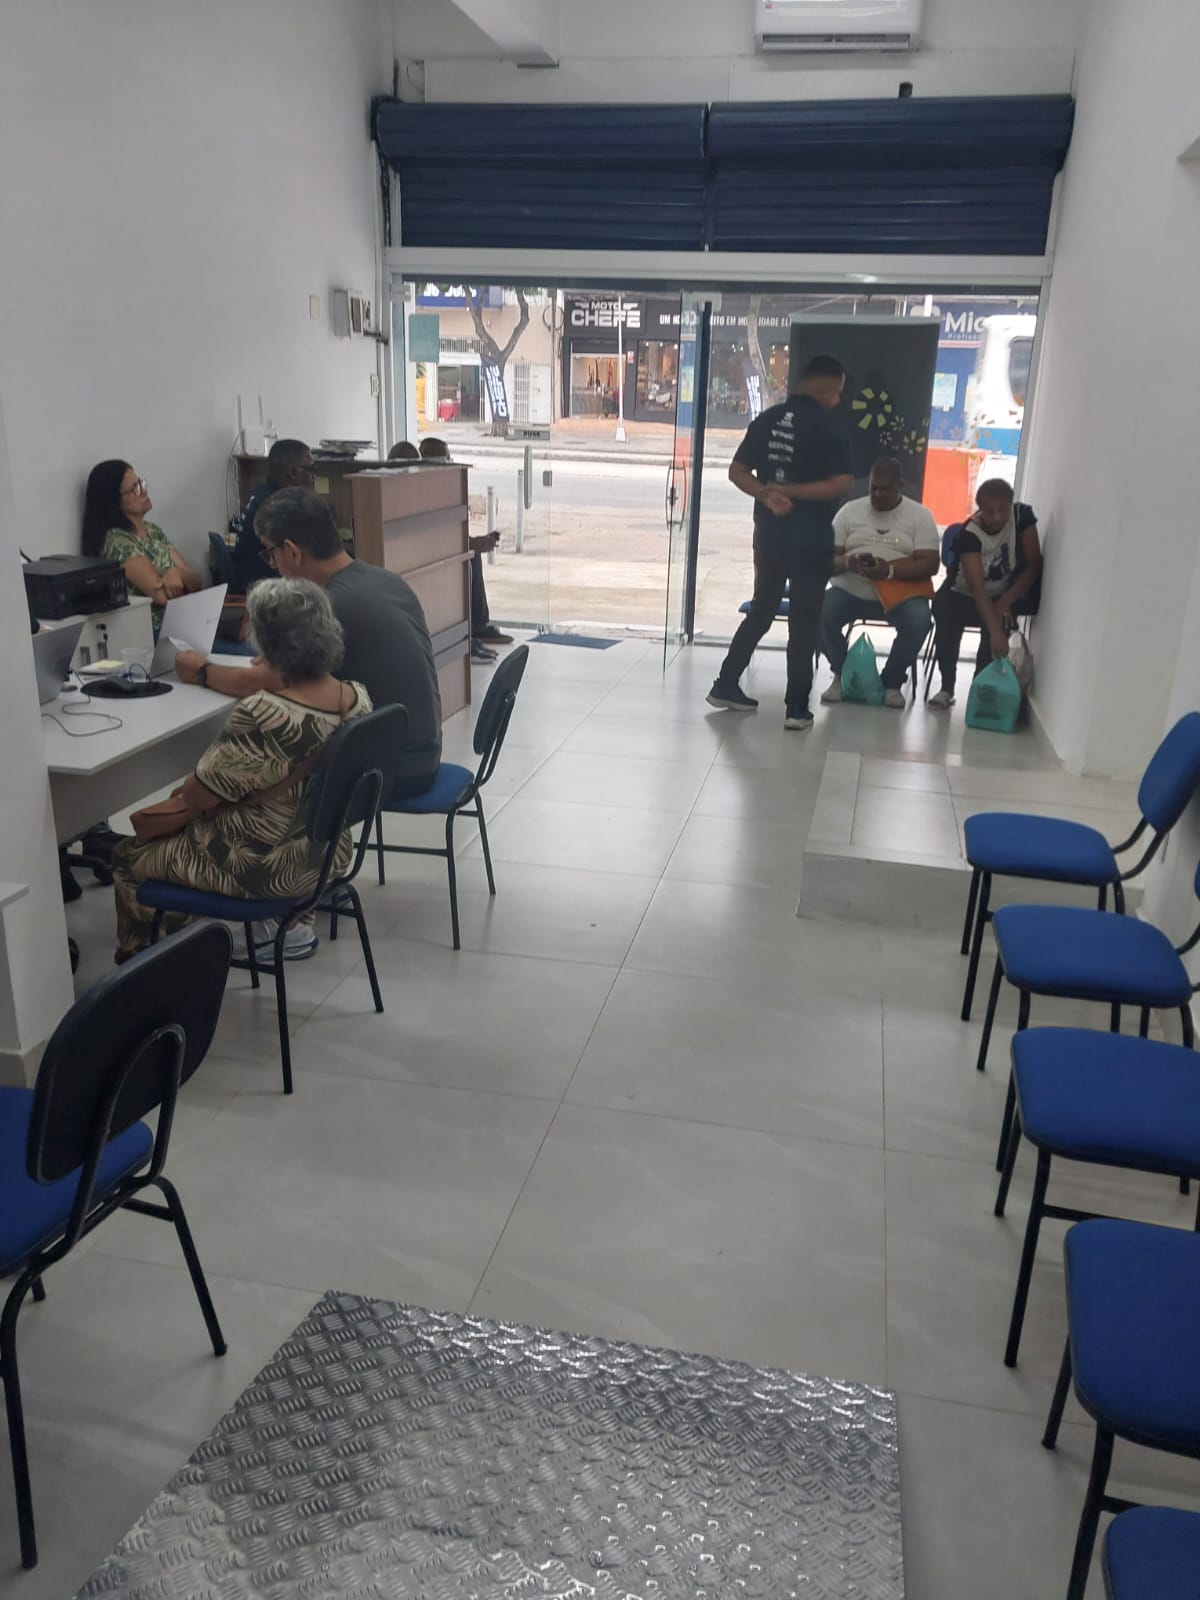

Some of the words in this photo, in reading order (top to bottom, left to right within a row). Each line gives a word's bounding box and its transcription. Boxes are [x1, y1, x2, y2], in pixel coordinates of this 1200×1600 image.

[591, 301, 621, 310] MOTO
[571, 309, 641, 328] CHEFE
[659, 314, 671, 325] UM
